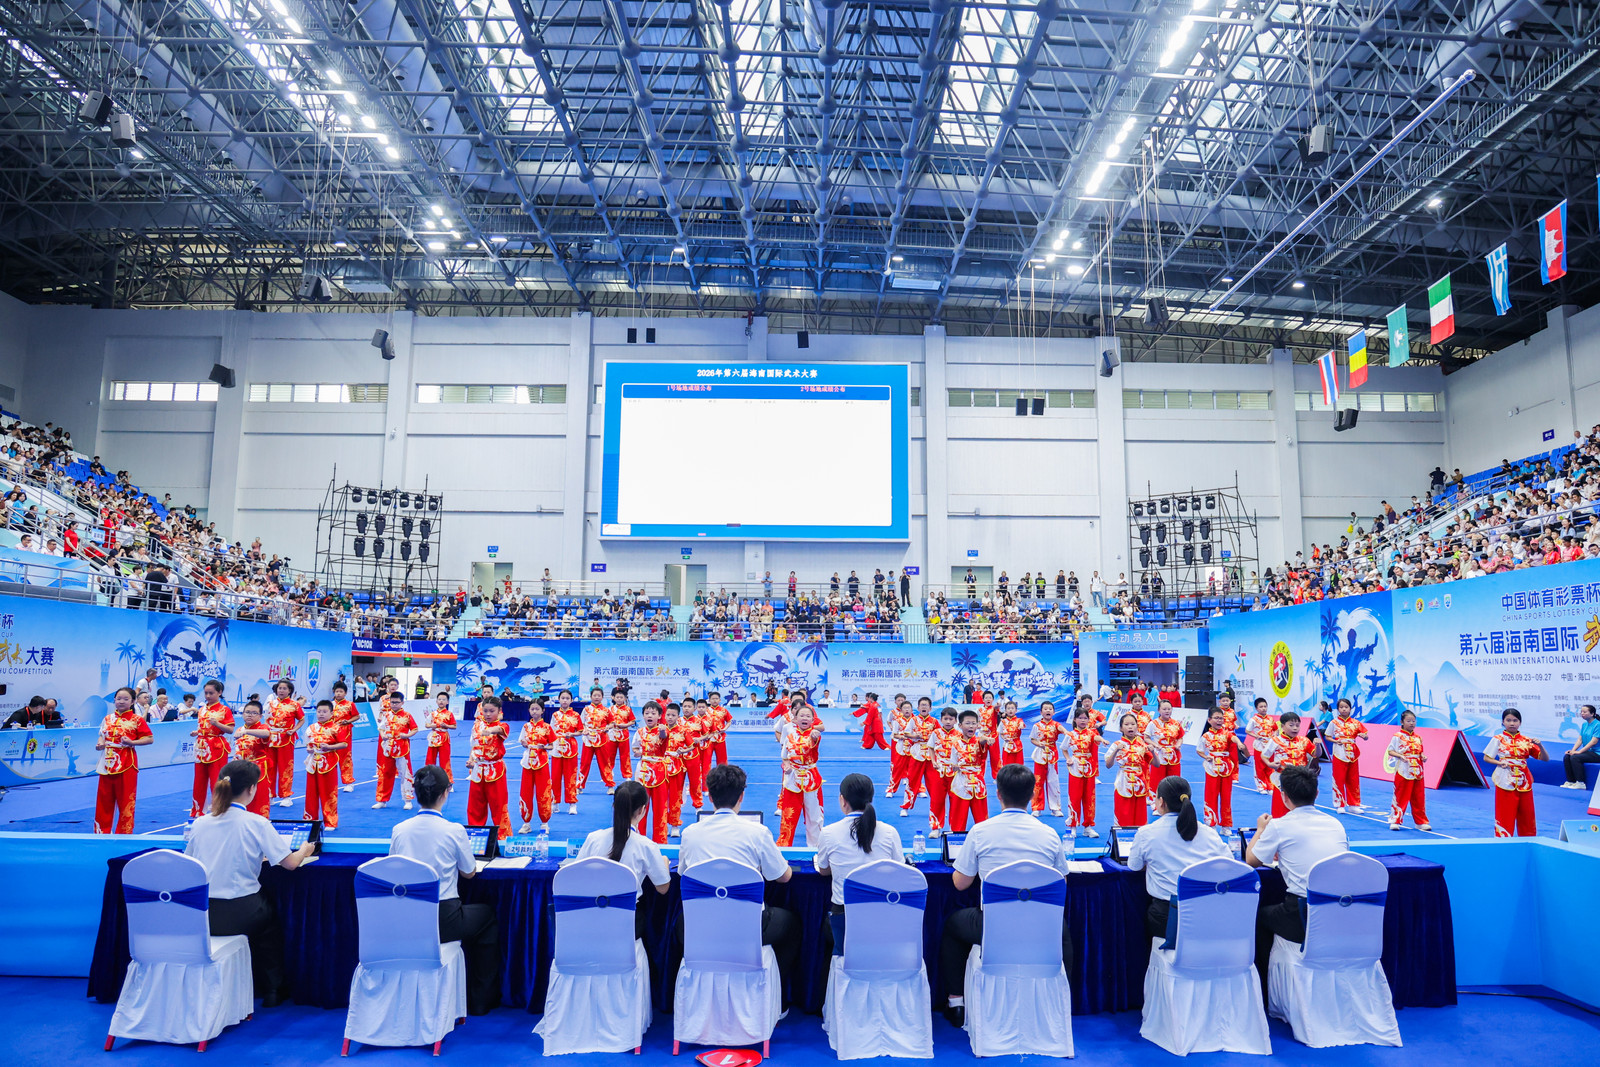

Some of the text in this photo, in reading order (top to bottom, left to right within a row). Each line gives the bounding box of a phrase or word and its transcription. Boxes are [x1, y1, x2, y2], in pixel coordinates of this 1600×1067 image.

[1501, 582, 1600, 612] 中国体育彩票杯
[1502, 613, 1522, 622] CHINA
[1524, 611, 1551, 621] SPORTS
[1552, 608, 1586, 618] LOTTERY
[0, 613, 15, 630] 杯
[1107, 632, 1168, 644] 运动员入口
[355, 639, 373, 649] VICTOR
[1461, 658, 1473, 666] THE
[1483, 657, 1509, 665] HAINAN
[1510, 655, 1571, 665] INTERNATIONAL
[8, 667, 53, 675] COMPETITION
[1501, 673, 1552, 682] 2026.09.23-09.27
